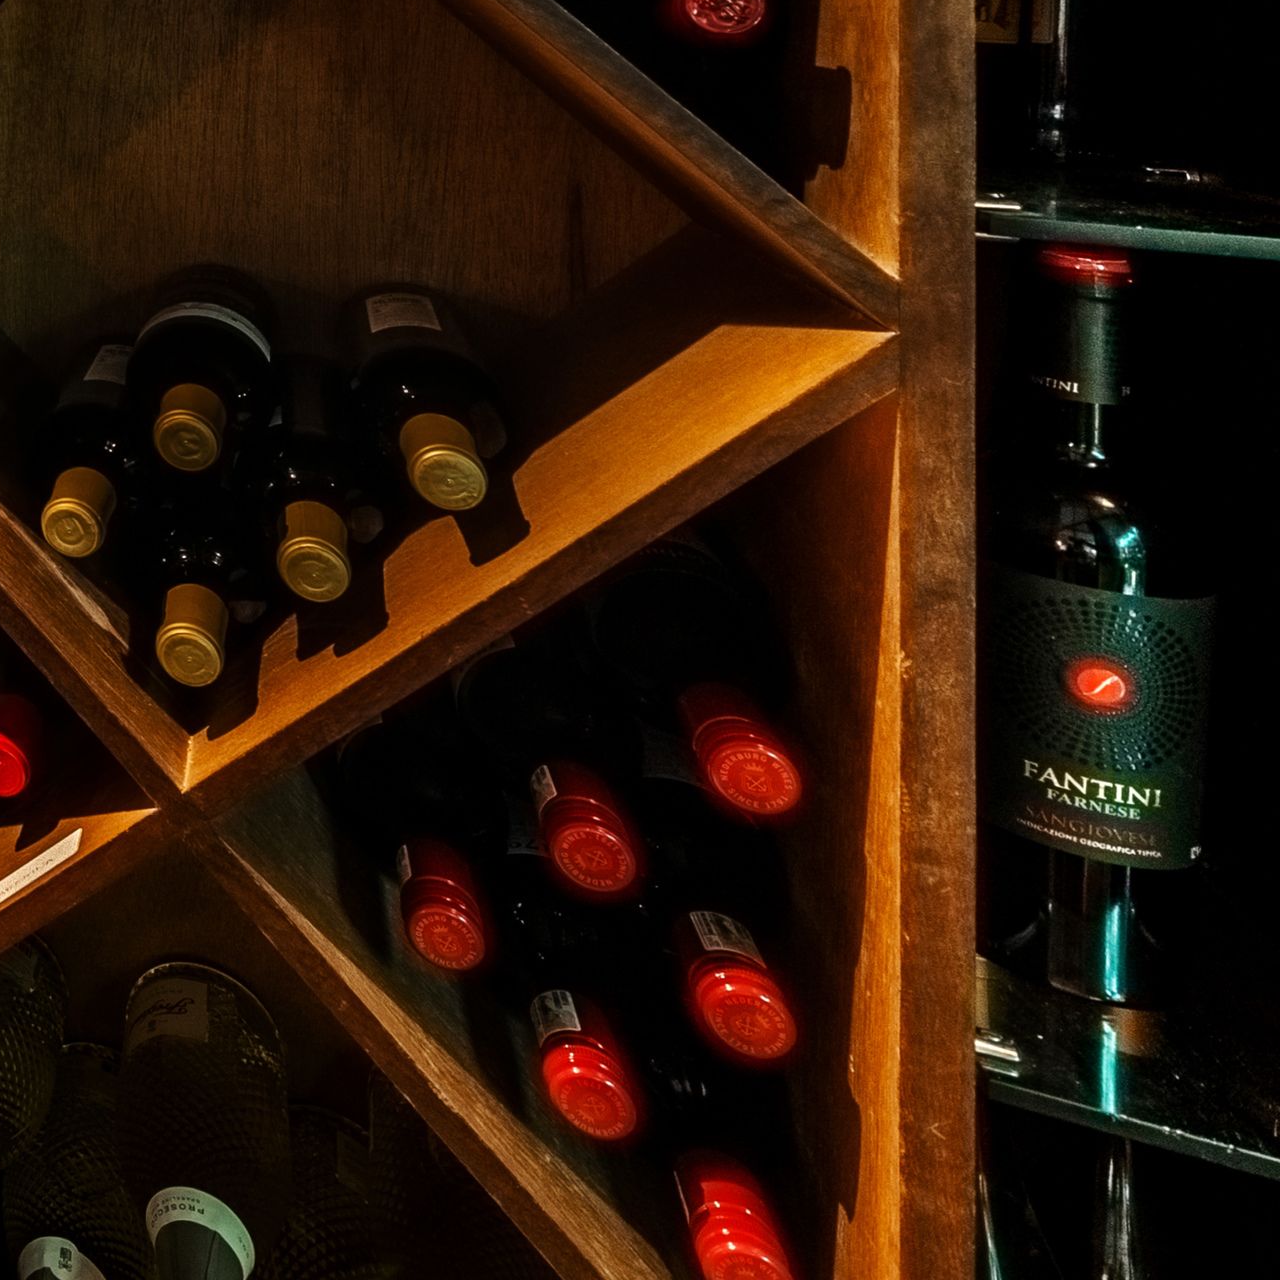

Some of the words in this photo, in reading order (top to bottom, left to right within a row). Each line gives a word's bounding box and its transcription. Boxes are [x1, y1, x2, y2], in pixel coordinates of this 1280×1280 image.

[720, 752, 769, 781] NEDERBURG
[728, 787, 760, 809] SINCE
[1023, 759, 1162, 808] FANTINI
[1046, 787, 1141, 821] FARNESE
[1080, 837, 1137, 857] GEOGRAFICA
